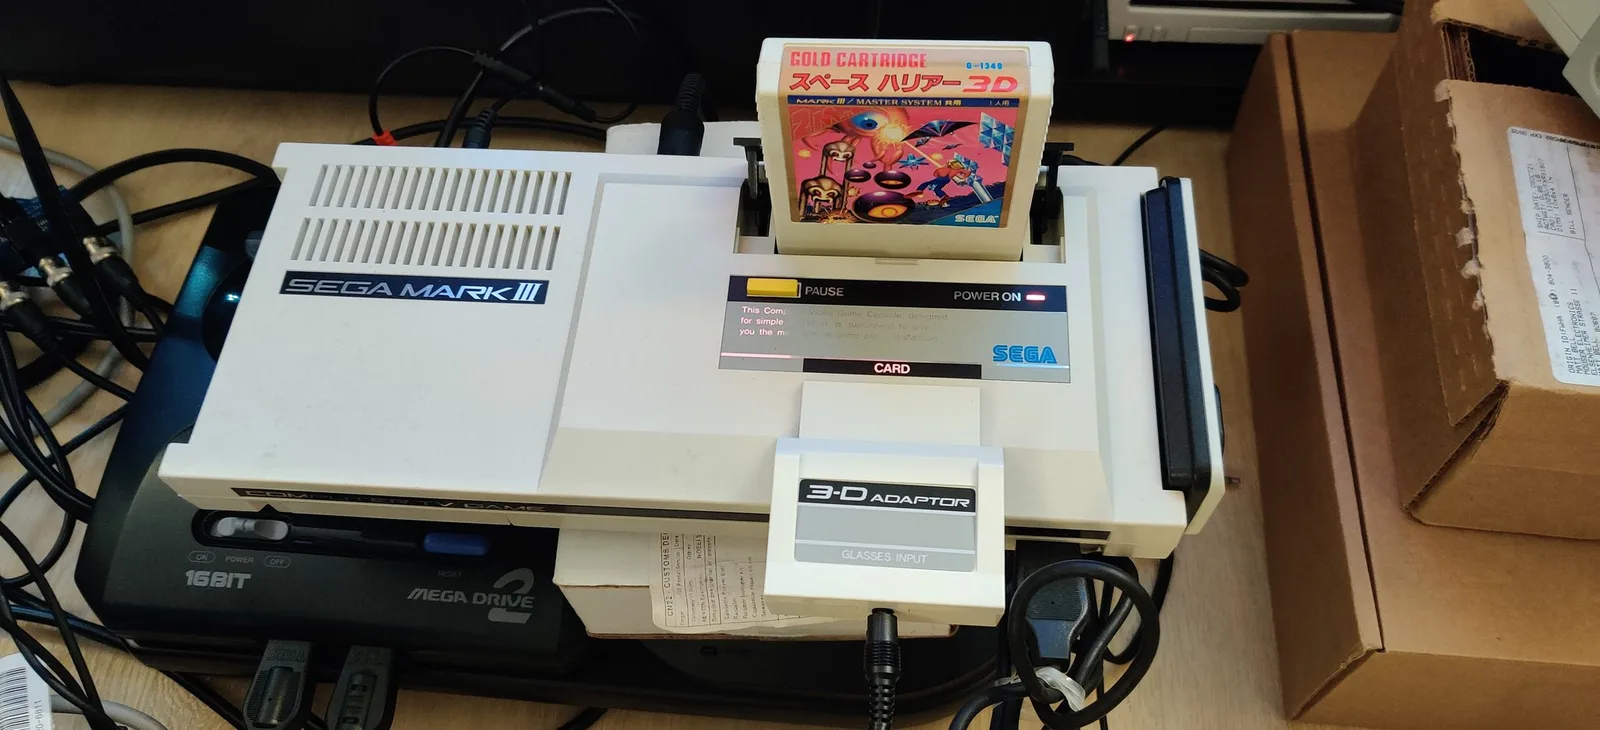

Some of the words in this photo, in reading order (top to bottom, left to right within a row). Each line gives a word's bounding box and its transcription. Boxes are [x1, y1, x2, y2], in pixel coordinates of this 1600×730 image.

[790, 51, 831, 67] GOLD
[836, 52, 927, 68] CARTRIDGE
[789, 72, 869, 92] スペース
[877, 73, 961, 93] ハリアー
[962, 75, 1018, 93] 3D
[856, 98, 898, 106] MASTER
[1563, 193, 1572, 216] SENDER
[955, 214, 997, 223] SEGA
[1568, 220, 1576, 235] BILL
[285, 278, 393, 297] SEGA
[400, 283, 513, 301] MARK
[511, 282, 543, 302] III
[805, 286, 844, 298] PAUSE
[953, 290, 999, 301] POWER
[1001, 291, 1022, 302] ON
[742, 306, 763, 314] This
[1573, 298, 1586, 327] STRASSE
[740, 316, 752, 325] for
[756, 317, 784, 327] simple
[1567, 302, 1583, 346] ELECTRONICS
[739, 328, 755, 336] you
[759, 327, 773, 336] the
[1570, 337, 1578, 353] BELL
[1581, 329, 1598, 376] ELSENHEIMER
[992, 344, 1057, 364] SEGA
[1564, 347, 1576, 374] ORIGIN
[1578, 348, 1590, 375] MOUSER
[873, 363, 911, 375] CARD
[1574, 356, 1583, 375] MATT
[806, 484, 868, 502] 3-D
[870, 493, 970, 508] ADAPTOR
[464, 503, 546, 512] GAME
[195, 553, 209, 561] ON
[225, 555, 255, 564] POWER
[269, 558, 285, 566] OFF
[841, 549, 891, 562] GLASSES
[896, 553, 928, 564] INPUT
[438, 569, 462, 578] RESET
[663, 548, 671, 589] CUSTOMS
[185, 569, 252, 589] 16BIT
[407, 587, 468, 604] MEGA
[472, 591, 535, 608] DRIVE
